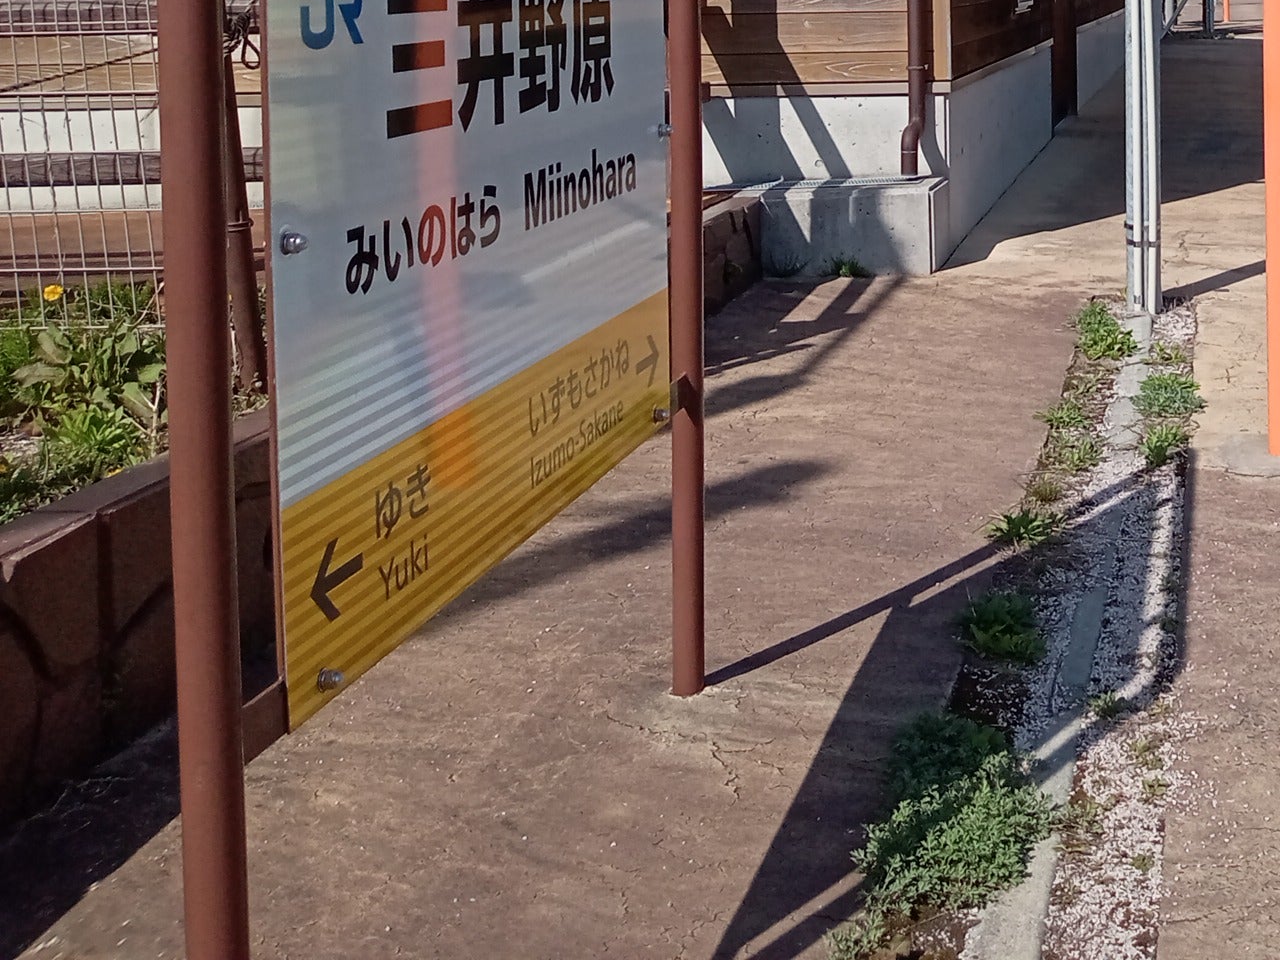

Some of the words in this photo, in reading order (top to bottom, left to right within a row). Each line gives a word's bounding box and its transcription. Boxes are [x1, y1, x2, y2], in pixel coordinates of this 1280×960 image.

[345, 185, 501, 295] みいのはら
[523, 148, 637, 231] Miinohara
[528, 338, 630, 438] いずもさかね
[530, 400, 625, 489] Izumo-Sakane
[374, 463, 432, 540] ゆき
[378, 533, 430, 600] Yuki
